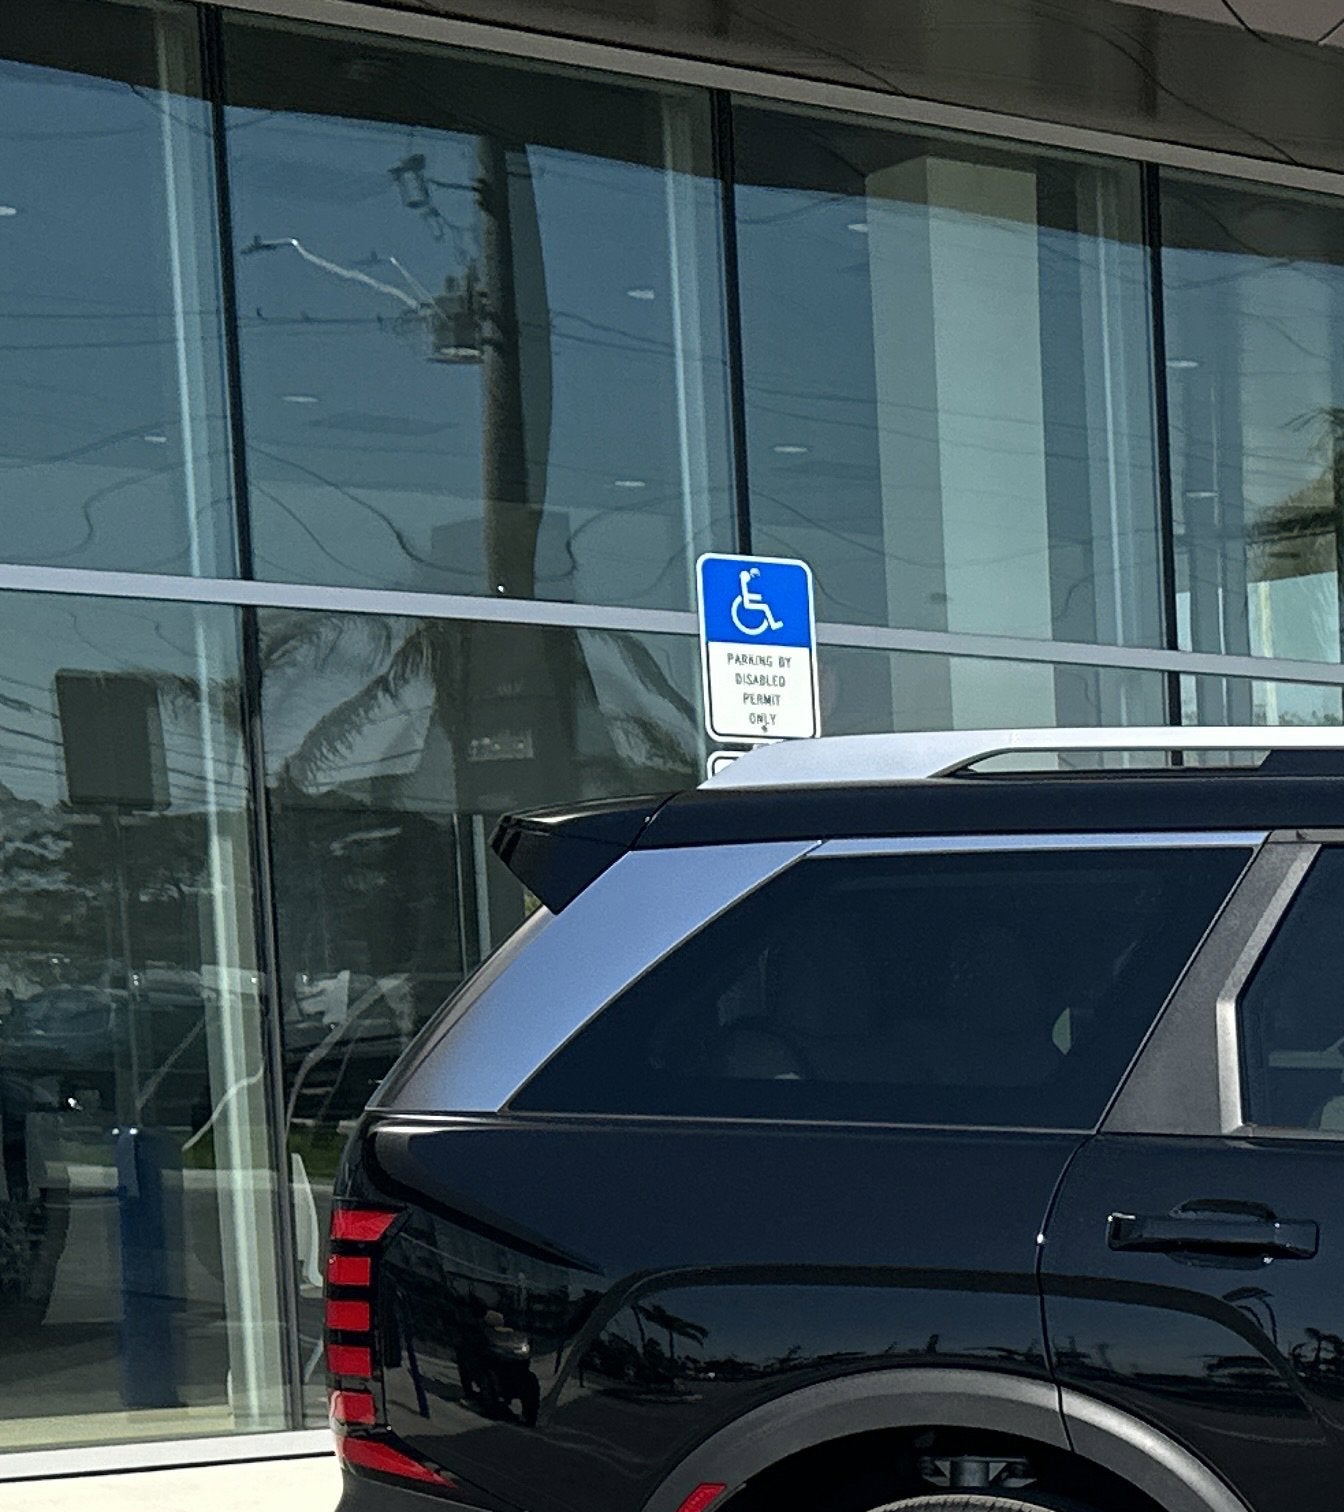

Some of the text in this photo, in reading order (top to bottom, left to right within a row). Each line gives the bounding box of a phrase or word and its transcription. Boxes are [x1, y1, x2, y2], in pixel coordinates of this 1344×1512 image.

[727, 652, 792, 668] PARKING BY
[735, 672, 786, 688] DISABLED
[743, 692, 781, 706] PERMIT
[749, 712, 777, 726] ONLY
